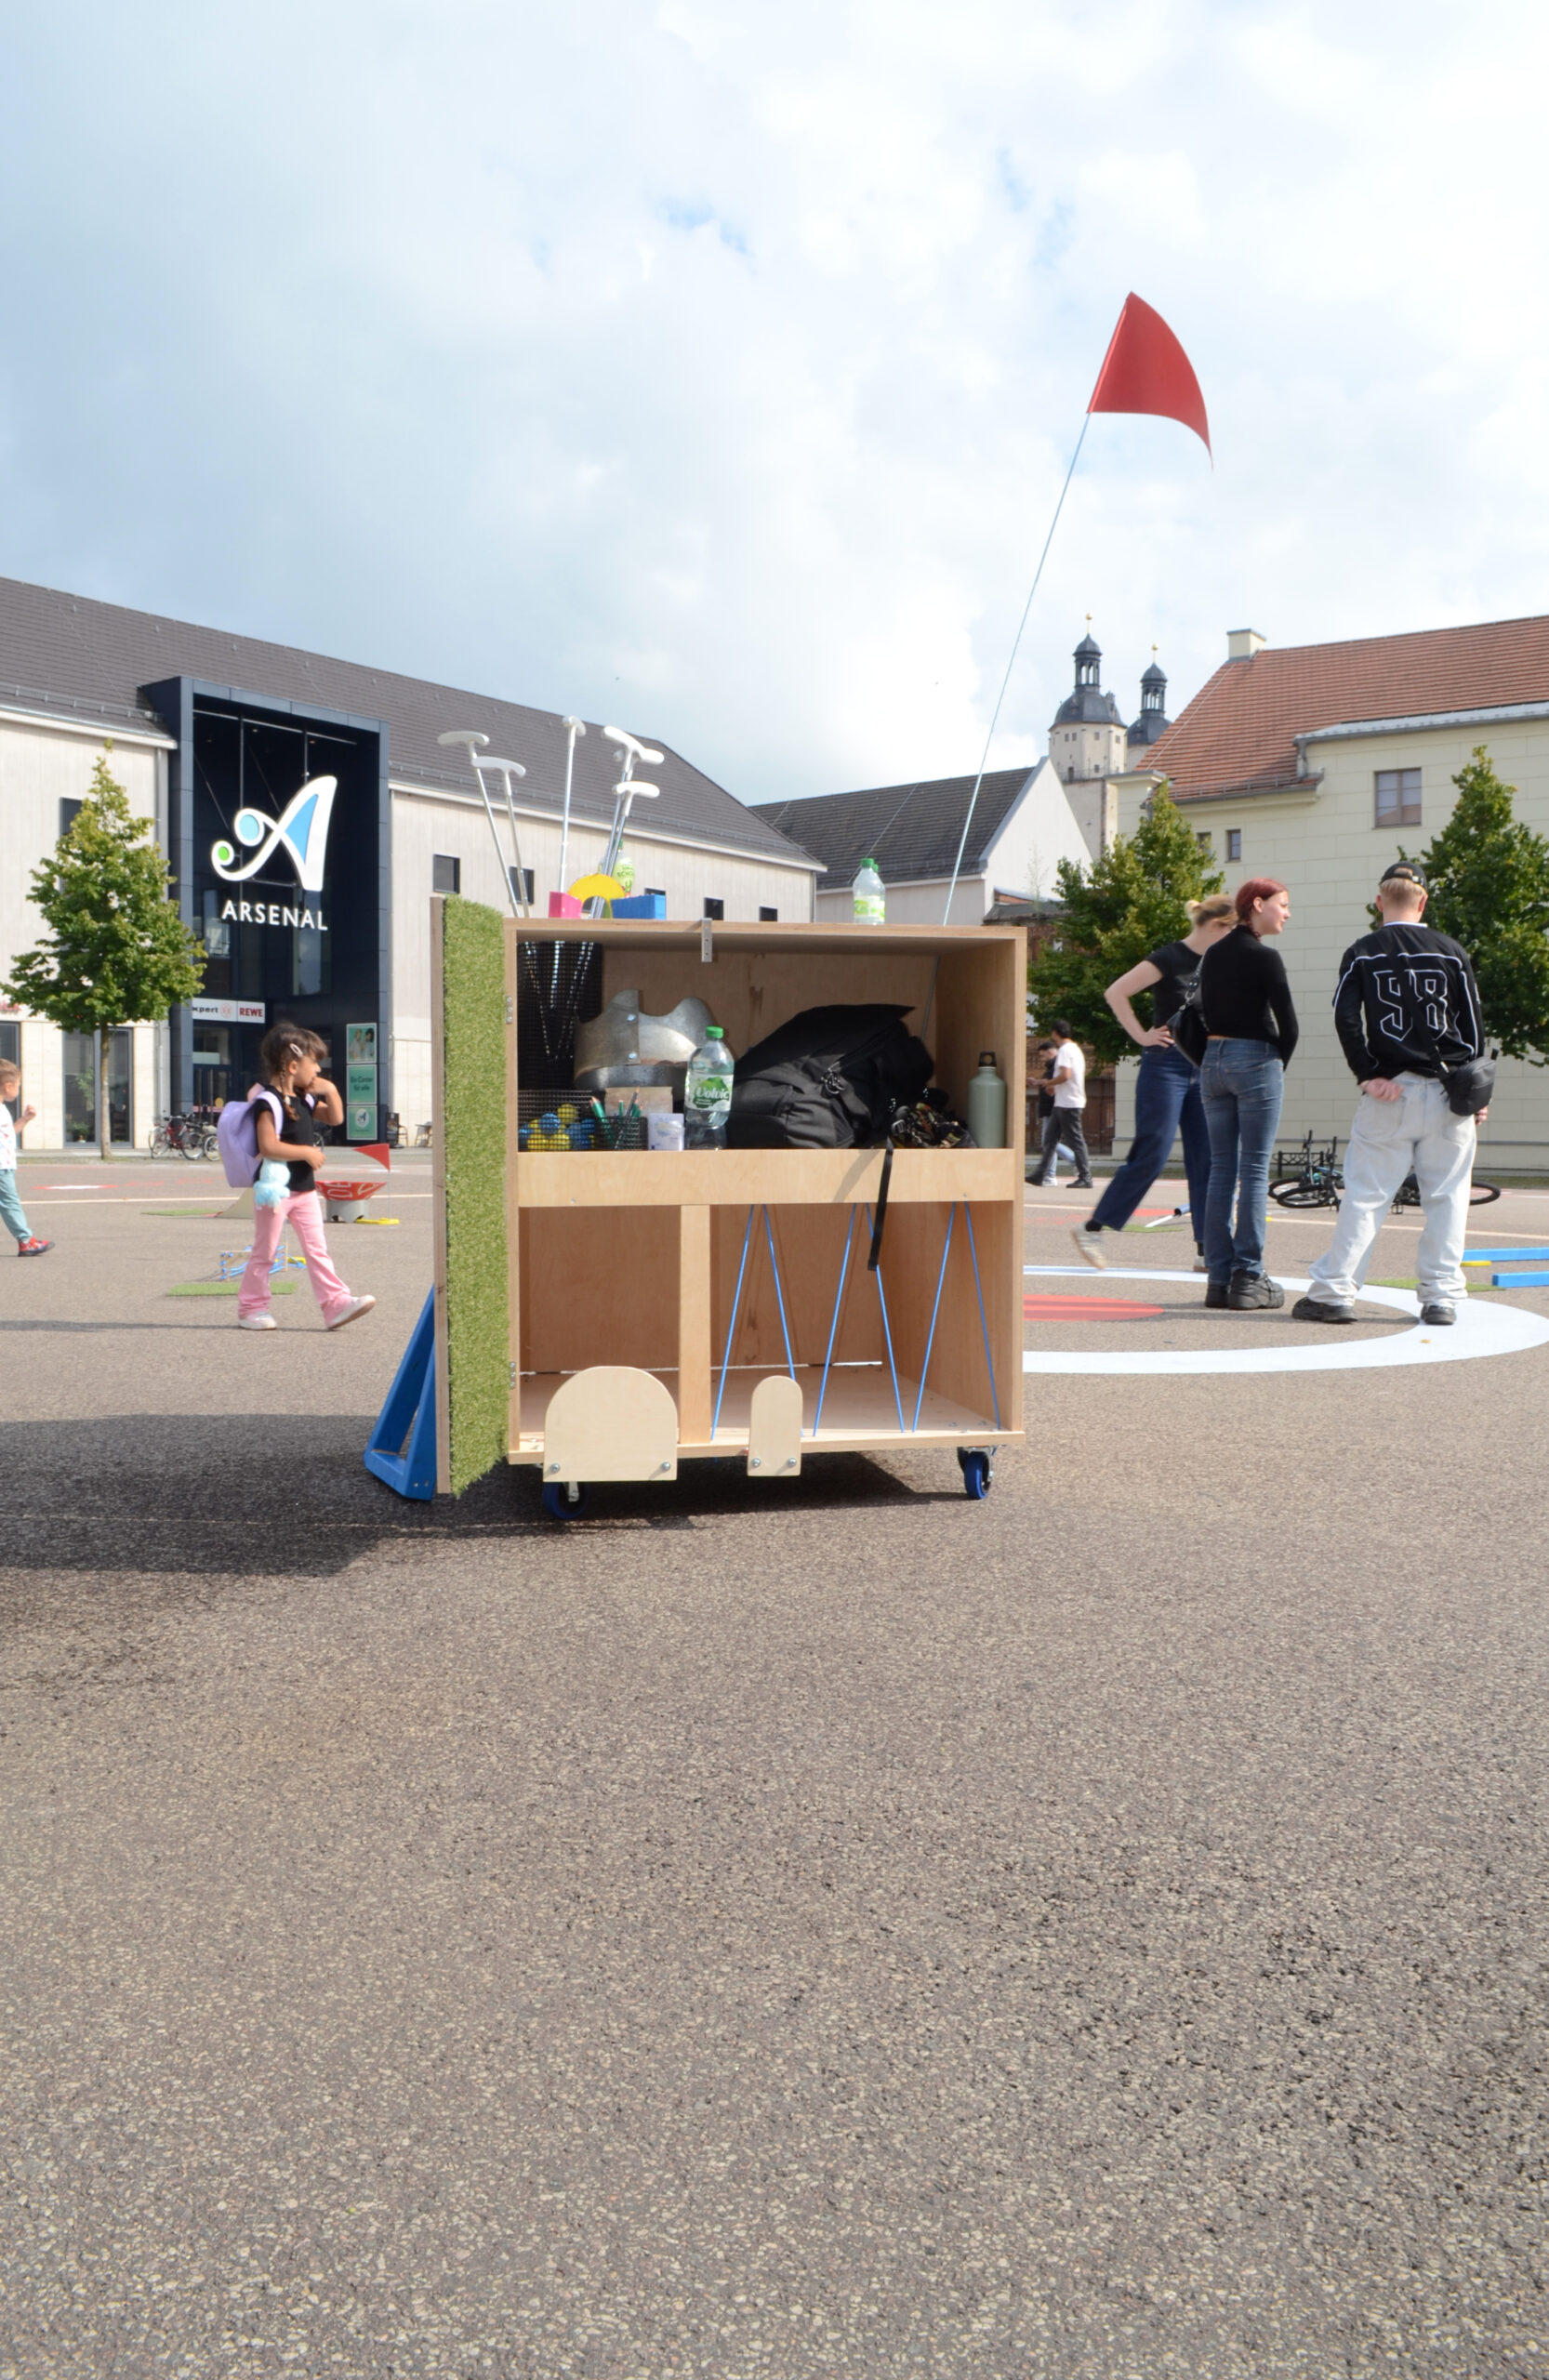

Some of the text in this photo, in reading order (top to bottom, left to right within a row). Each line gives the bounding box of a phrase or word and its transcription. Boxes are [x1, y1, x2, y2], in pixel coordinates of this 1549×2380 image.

[221, 899, 328, 931] ARSENAL
[192, 1006, 218, 1014] xpert
[239, 1007, 263, 1018] REWE
[696, 1087, 730, 1099] Volvic
